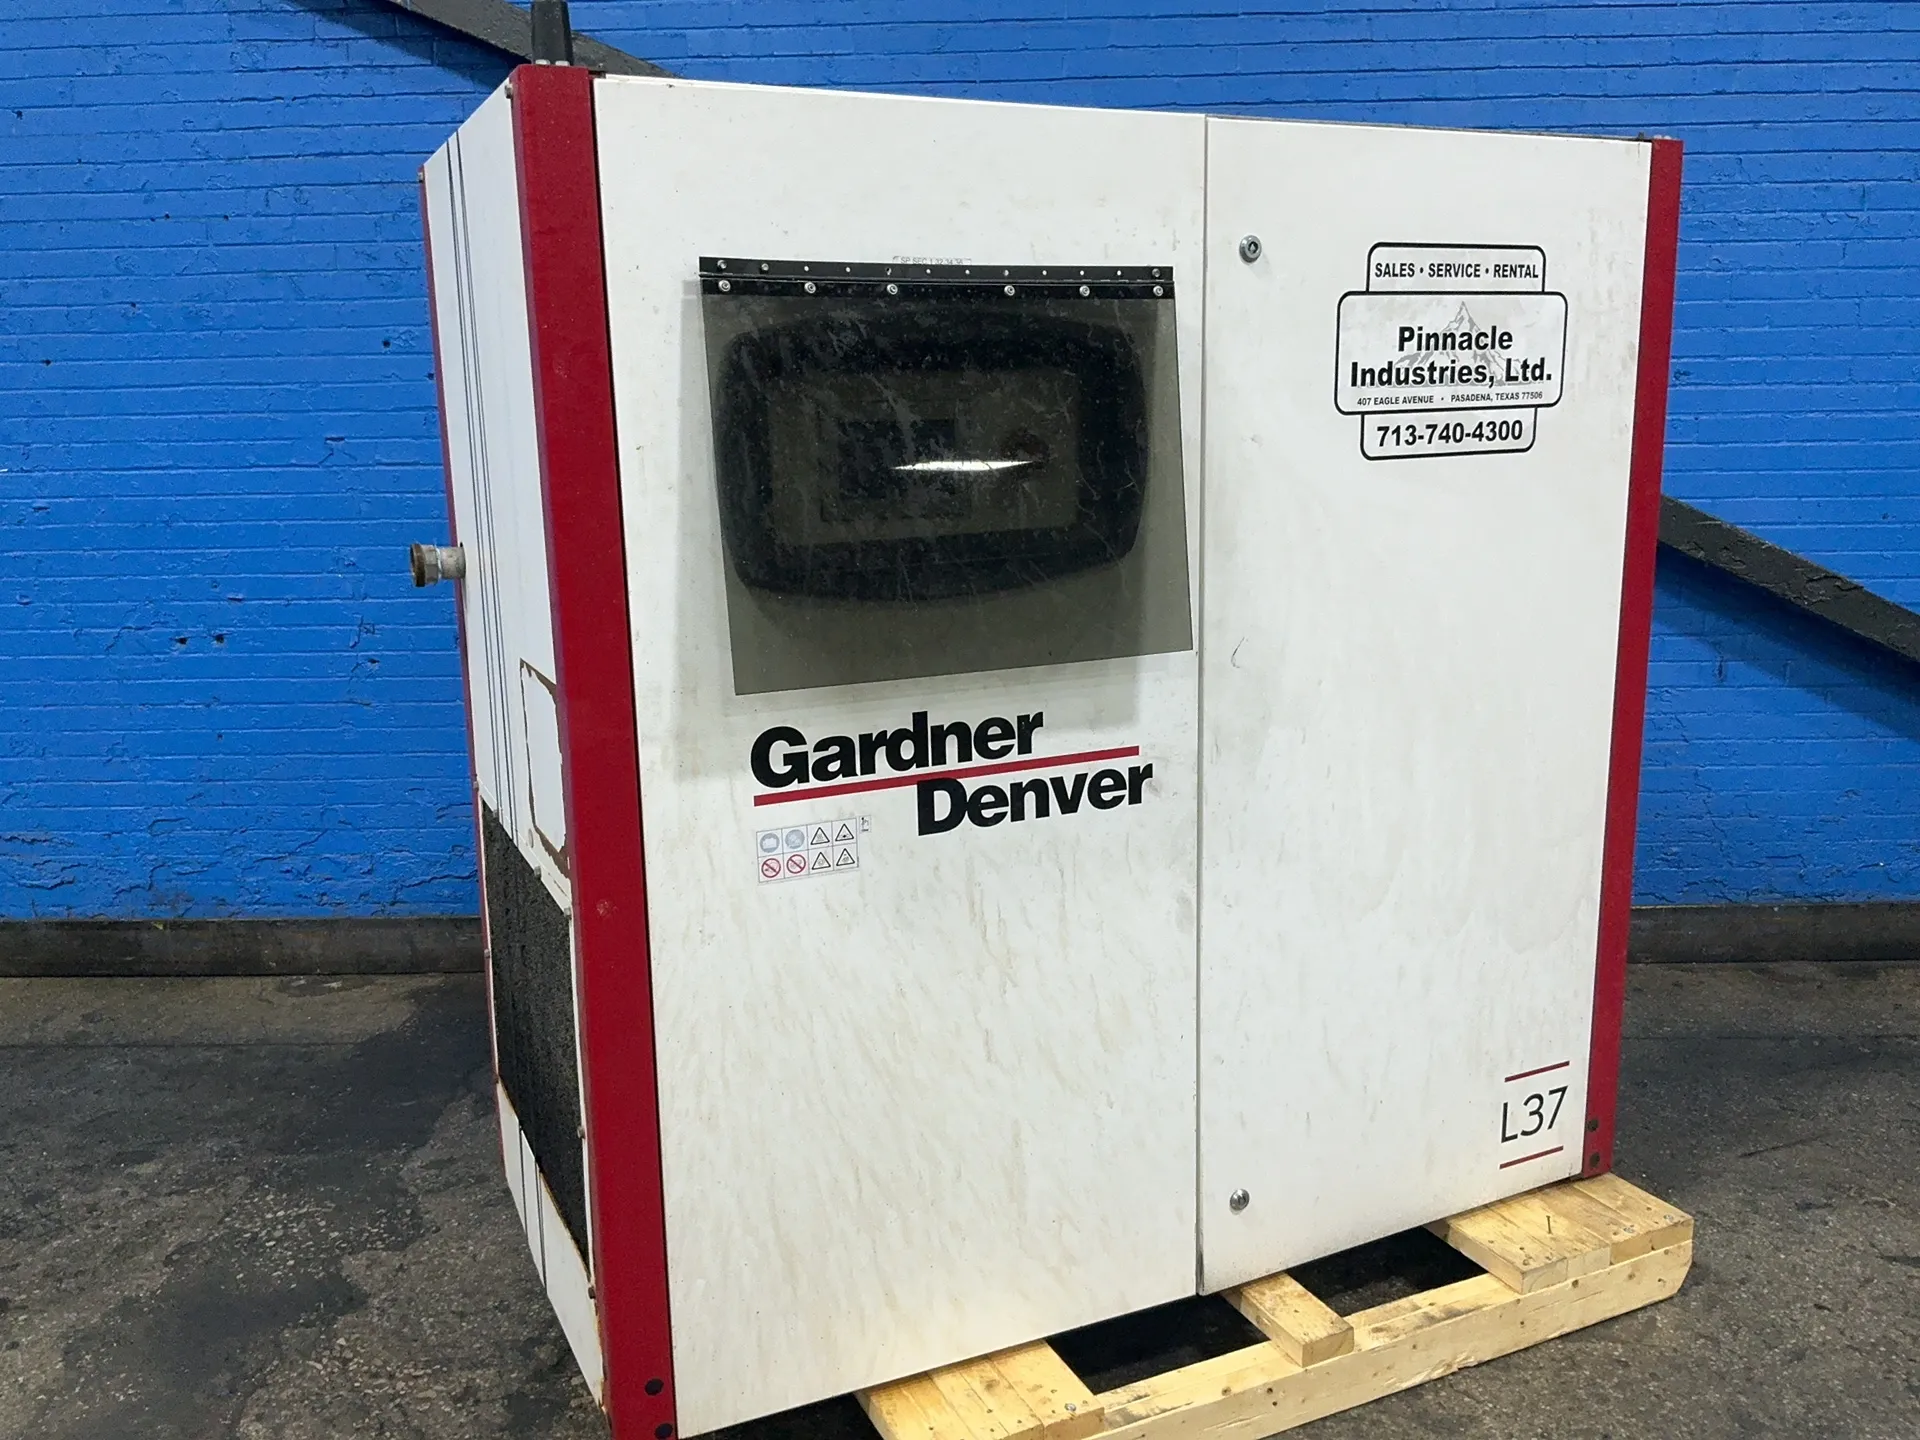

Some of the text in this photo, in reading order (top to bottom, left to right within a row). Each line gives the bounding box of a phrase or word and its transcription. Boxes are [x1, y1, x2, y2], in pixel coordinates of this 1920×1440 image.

[1375, 263, 1539, 279] SALES SERVICE RENTAL
[1398, 325, 1513, 352] Pinnacle
[1351, 357, 1552, 388] Industries, Ltd.
[1357, 391, 1543, 406] 407 EAGLE AVENUE PASADENA, TEXAS 77506
[1376, 420, 1523, 447] 713-740-4300
[750, 711, 1043, 789] Gardner
[917, 763, 1153, 836] Denver
[1501, 1085, 1568, 1144] L37
